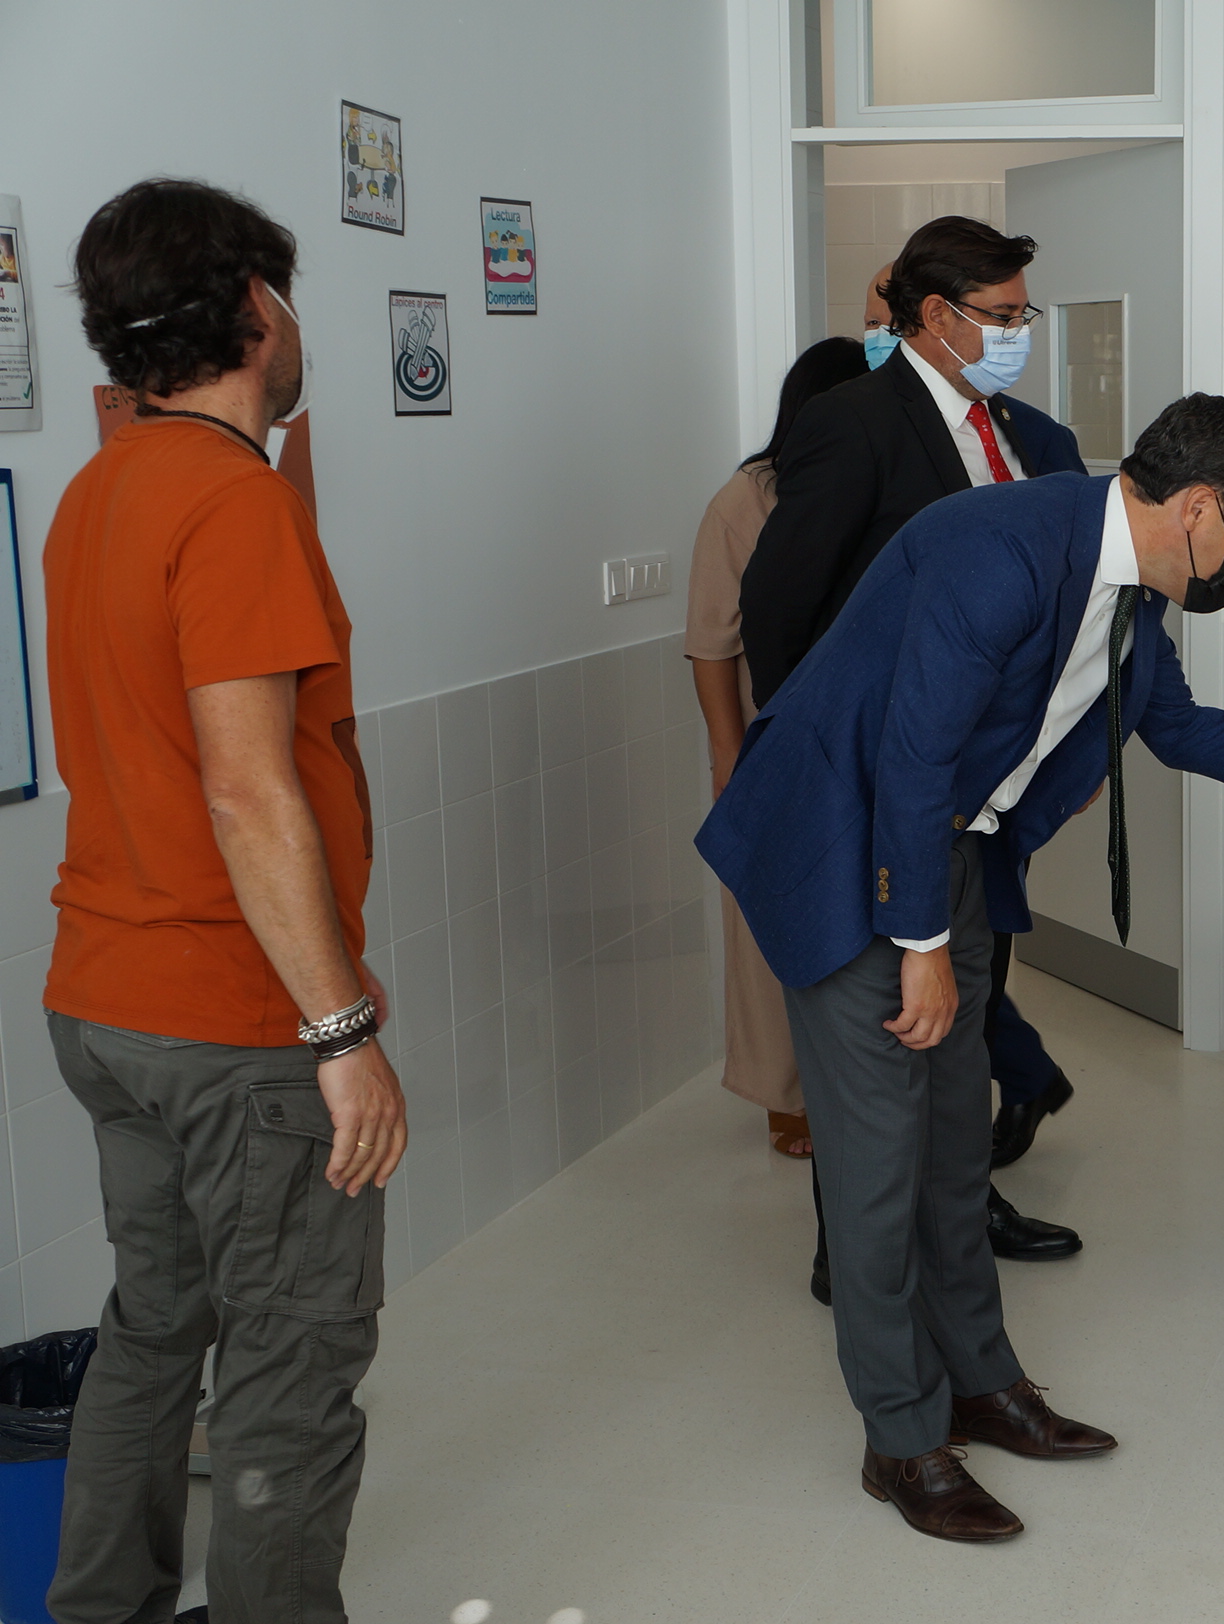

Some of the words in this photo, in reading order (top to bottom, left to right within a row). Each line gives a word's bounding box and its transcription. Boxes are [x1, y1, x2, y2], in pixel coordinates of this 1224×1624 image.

[347, 205, 374, 222] Round
[375, 211, 397, 228] Robin
[491, 207, 521, 222] Lectura
[487, 291, 535, 307] Compartida
